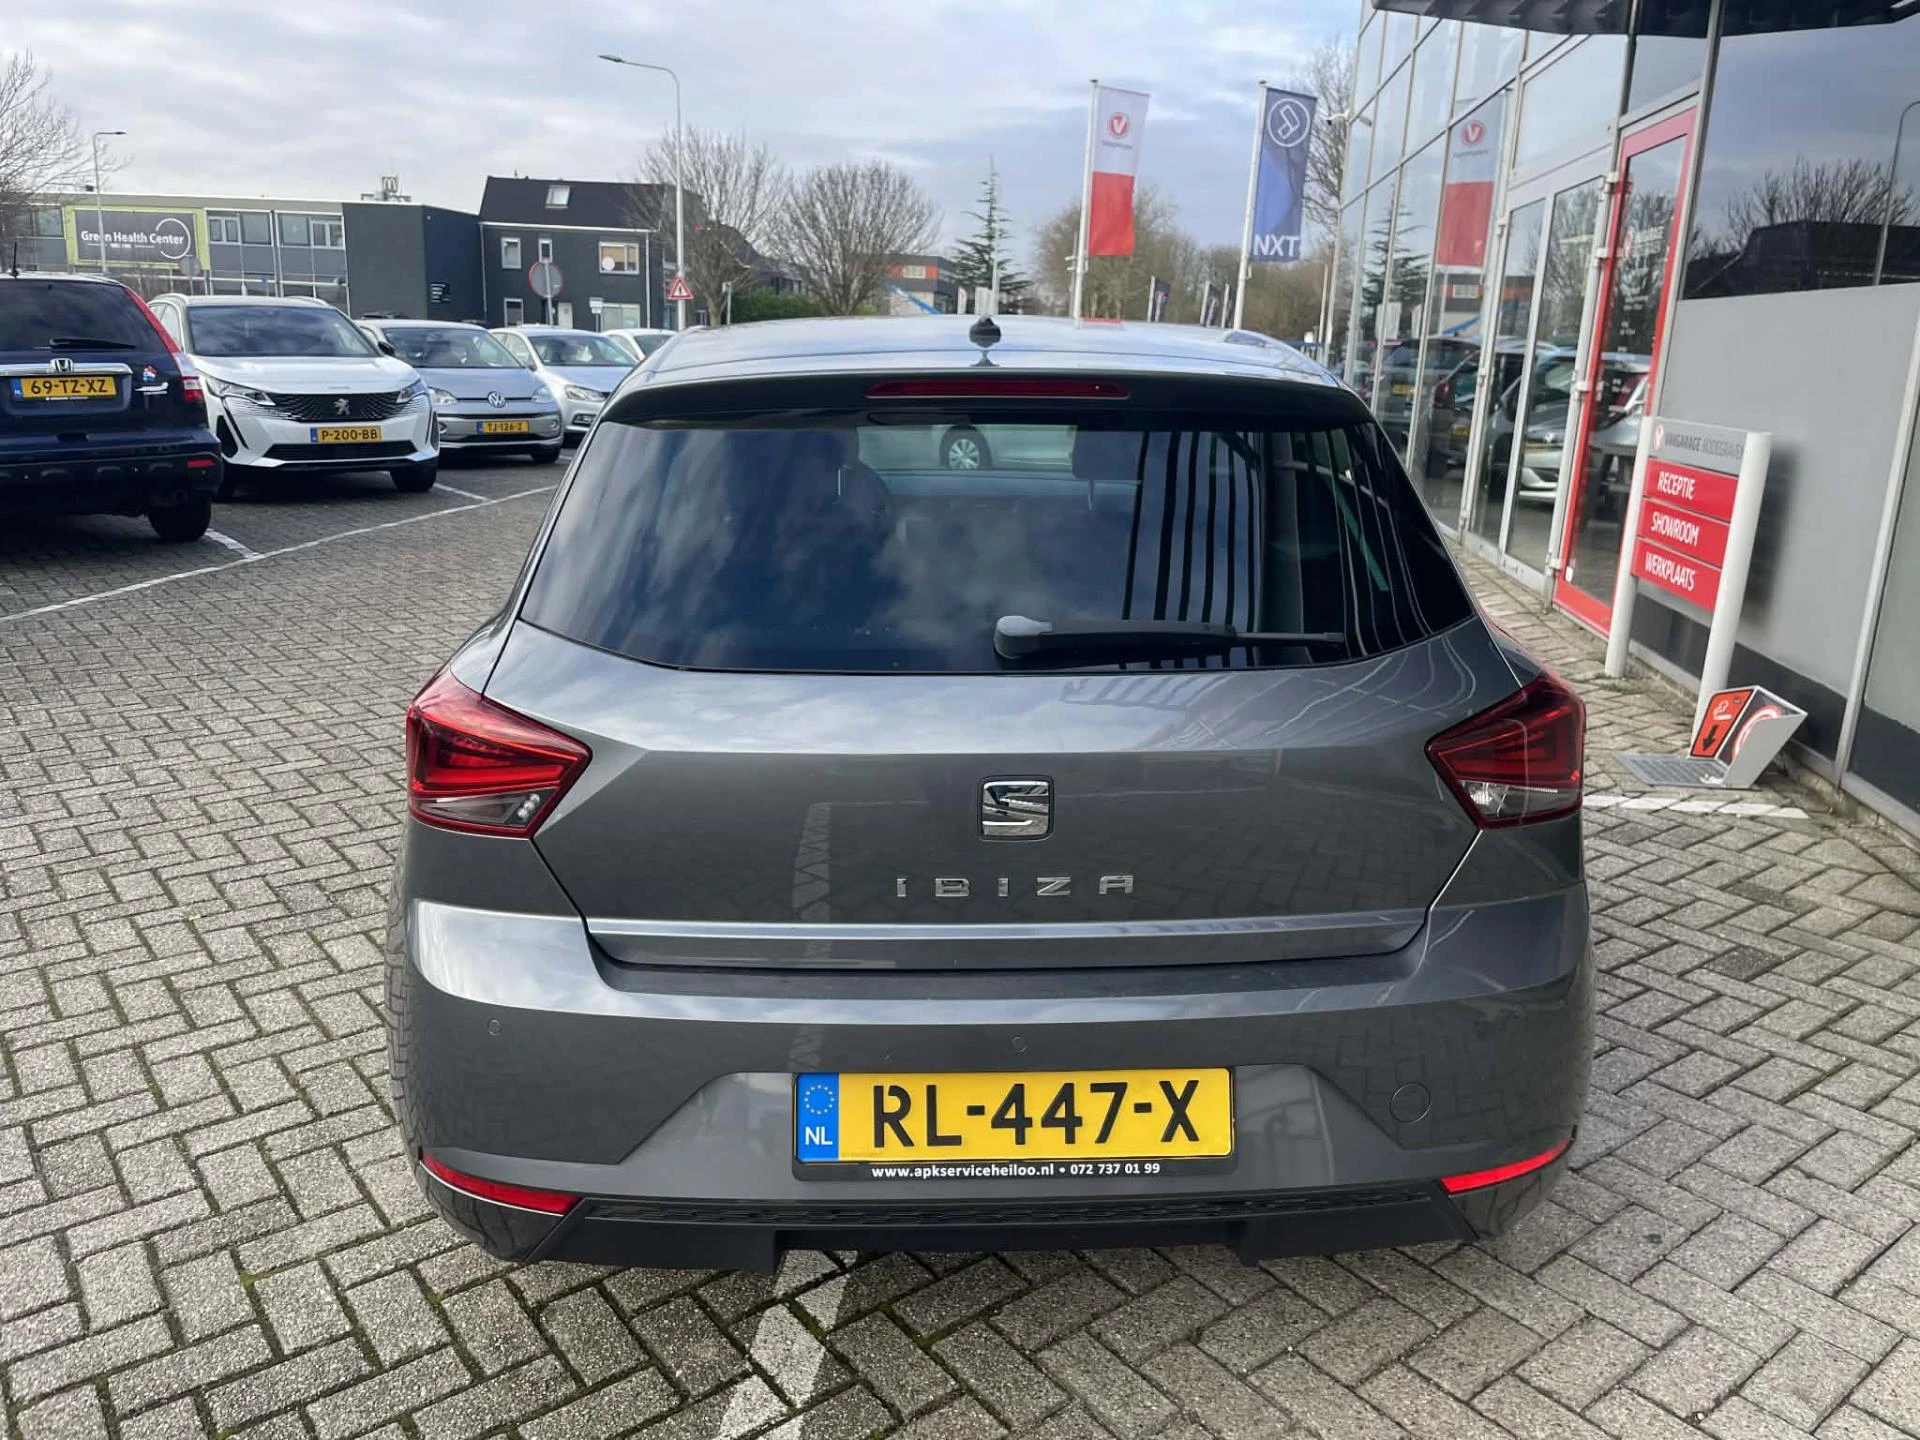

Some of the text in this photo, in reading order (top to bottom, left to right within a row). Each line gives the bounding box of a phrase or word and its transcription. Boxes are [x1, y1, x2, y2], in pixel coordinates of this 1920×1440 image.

[113, 232, 148, 244] Health
[149, 233, 184, 245] Center
[1253, 234, 1299, 256] NXT
[31, 379, 109, 394] 69-TZ-XZ
[1657, 471, 1695, 500] RECEPTIE
[1651, 511, 1699, 547] SHOWROOM
[1644, 552, 1695, 591] WERKPLAATS
[896, 875, 1134, 897] IBIZA
[872, 1079, 1200, 1149] RL-447-X
[805, 1126, 833, 1146] NL
[872, 1162, 1161, 1179] www.apkserviceheiloo.nl 072 737 01 99
